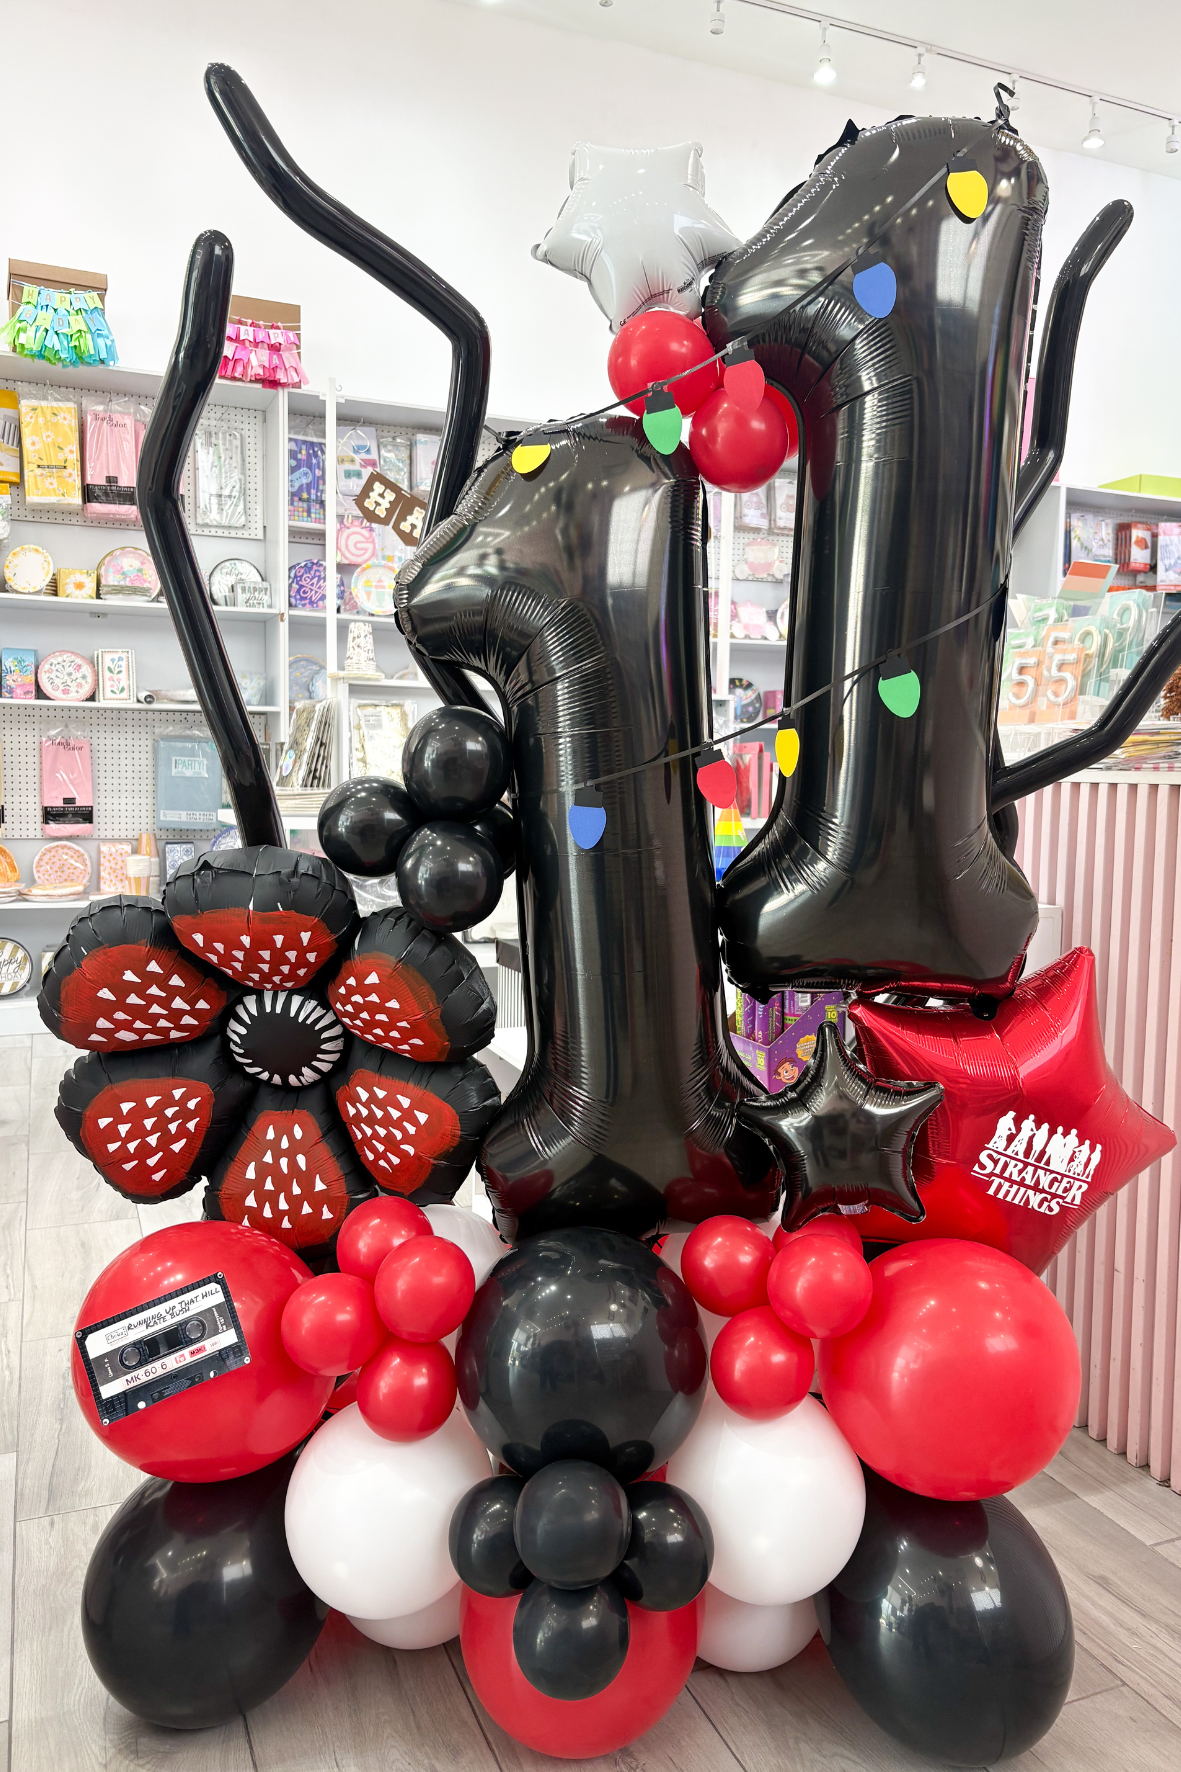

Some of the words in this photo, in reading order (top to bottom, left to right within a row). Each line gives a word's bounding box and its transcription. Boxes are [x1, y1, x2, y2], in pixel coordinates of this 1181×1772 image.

[27, 289, 97, 306] HAPPY
[24, 309, 97, 327] B-DAY
[93, 412, 114, 423] Touch
[106, 420, 128, 429] Color
[339, 527, 378, 565] G
[240, 585, 269, 595] HAPPY
[301, 573, 327, 592] GAM
[244, 594, 265, 604] you
[1007, 656, 1038, 708] 5
[1045, 654, 1076, 706] 5
[50, 739, 71, 747] Touch
[63, 744, 84, 752] Color
[178, 758, 202, 771] PARTY
[827, 1011, 837, 1019] 10
[972, 1149, 1089, 1206] STRANGER
[985, 1175, 1064, 1216] THINGS
[126, 1311, 163, 1331] RUNNING
[164, 1304, 177, 1316] UP
[177, 1295, 201, 1310] THAT
[201, 1286, 221, 1300] HILL
[145, 1316, 168, 1330] KATE
[170, 1306, 190, 1319] BUSH
